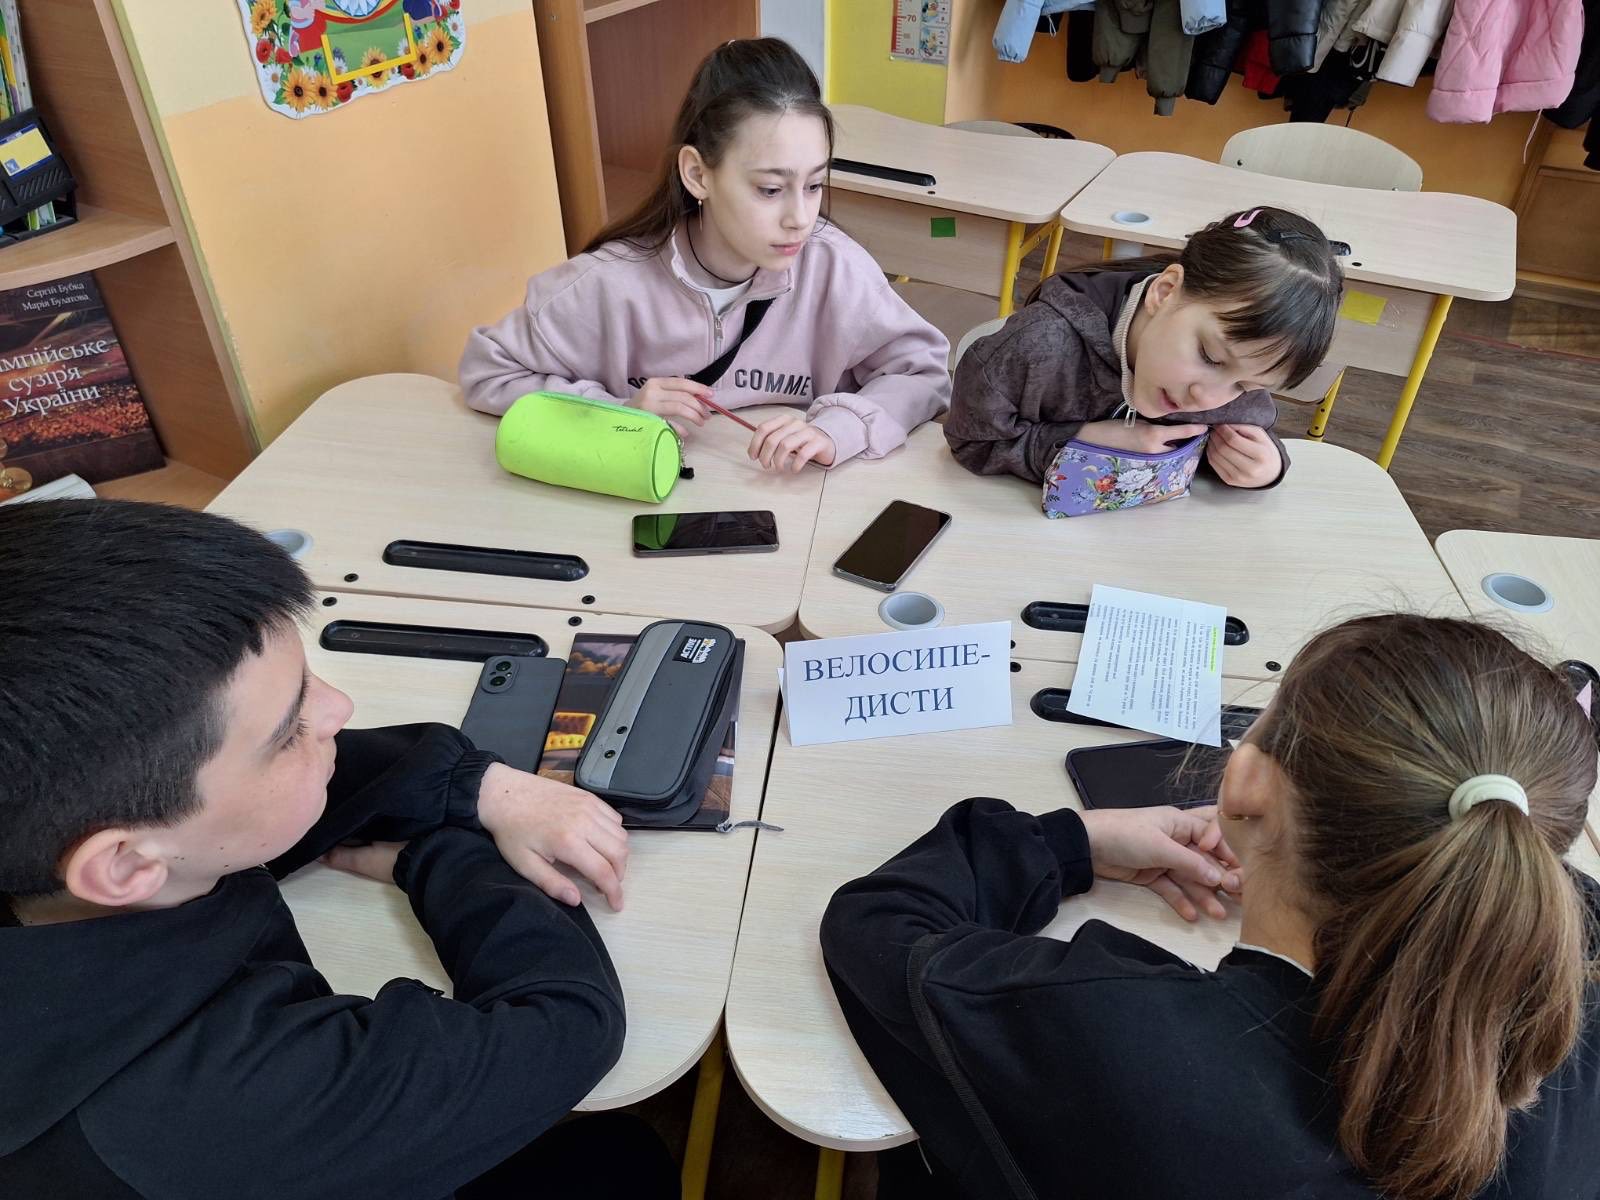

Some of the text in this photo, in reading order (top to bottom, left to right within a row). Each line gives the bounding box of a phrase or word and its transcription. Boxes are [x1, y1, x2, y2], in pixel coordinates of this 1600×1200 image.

[907, 14, 917, 22] 70
[905, 47, 915, 56] 60
[22, 293, 89, 312] Марія Булатова
[27, 282, 84, 299] Сергій Бубка
[0, 339, 109, 372] мпійське
[734, 368, 812, 396] COMME
[3, 385, 102, 416] України
[680, 638, 698, 659] ACTIVE
[803, 643, 991, 681] ВЕЛОСИПЕ-
[845, 686, 955, 725] ДИСТИ
